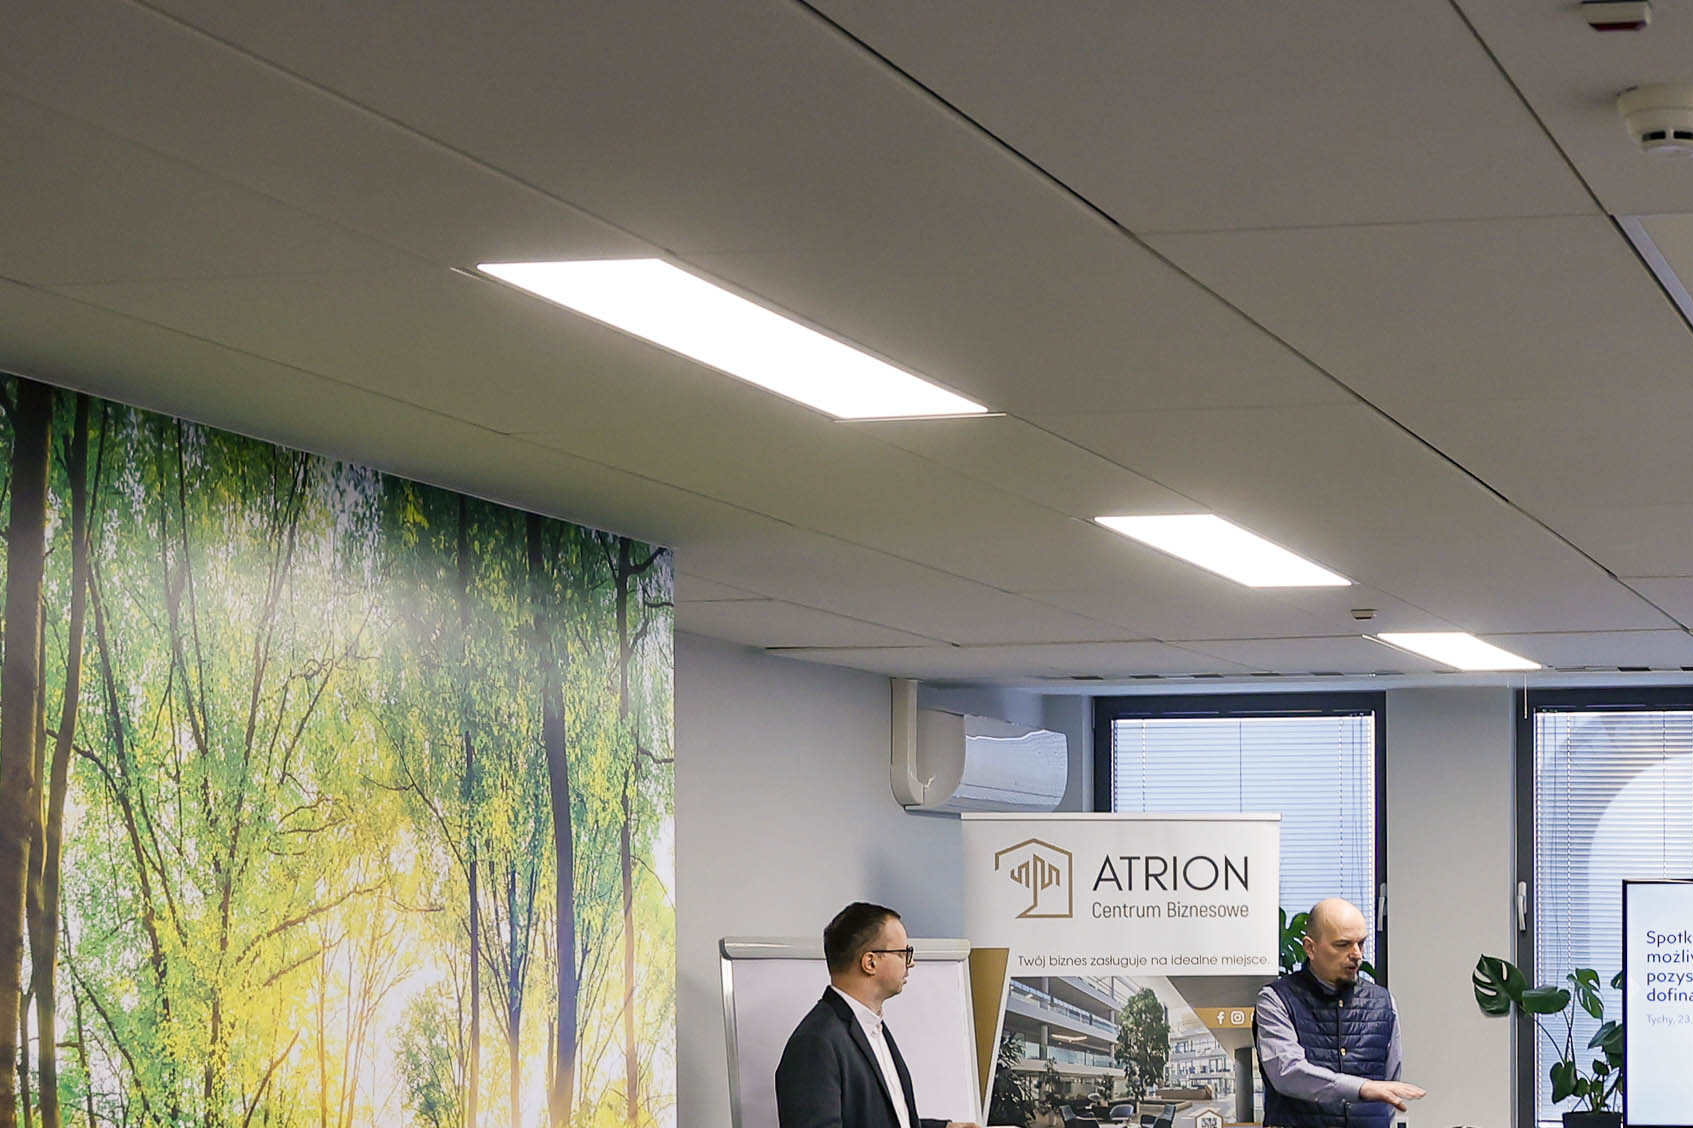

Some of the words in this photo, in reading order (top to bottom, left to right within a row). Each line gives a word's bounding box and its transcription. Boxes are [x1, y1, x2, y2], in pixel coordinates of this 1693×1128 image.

[1093, 854, 1249, 892] ATRION
[1092, 901, 1161, 920] Centrum
[1166, 900, 1249, 919] Biznesowe
[1018, 955, 1046, 968] Twój
[1049, 954, 1088, 967] biznes
[1090, 954, 1147, 968] zasługuje
[1151, 956, 1168, 967] na
[1171, 954, 1218, 966] idealne
[1221, 954, 1271, 967] miejsce.
[1646, 1014, 1676, 1026] Tychy,
